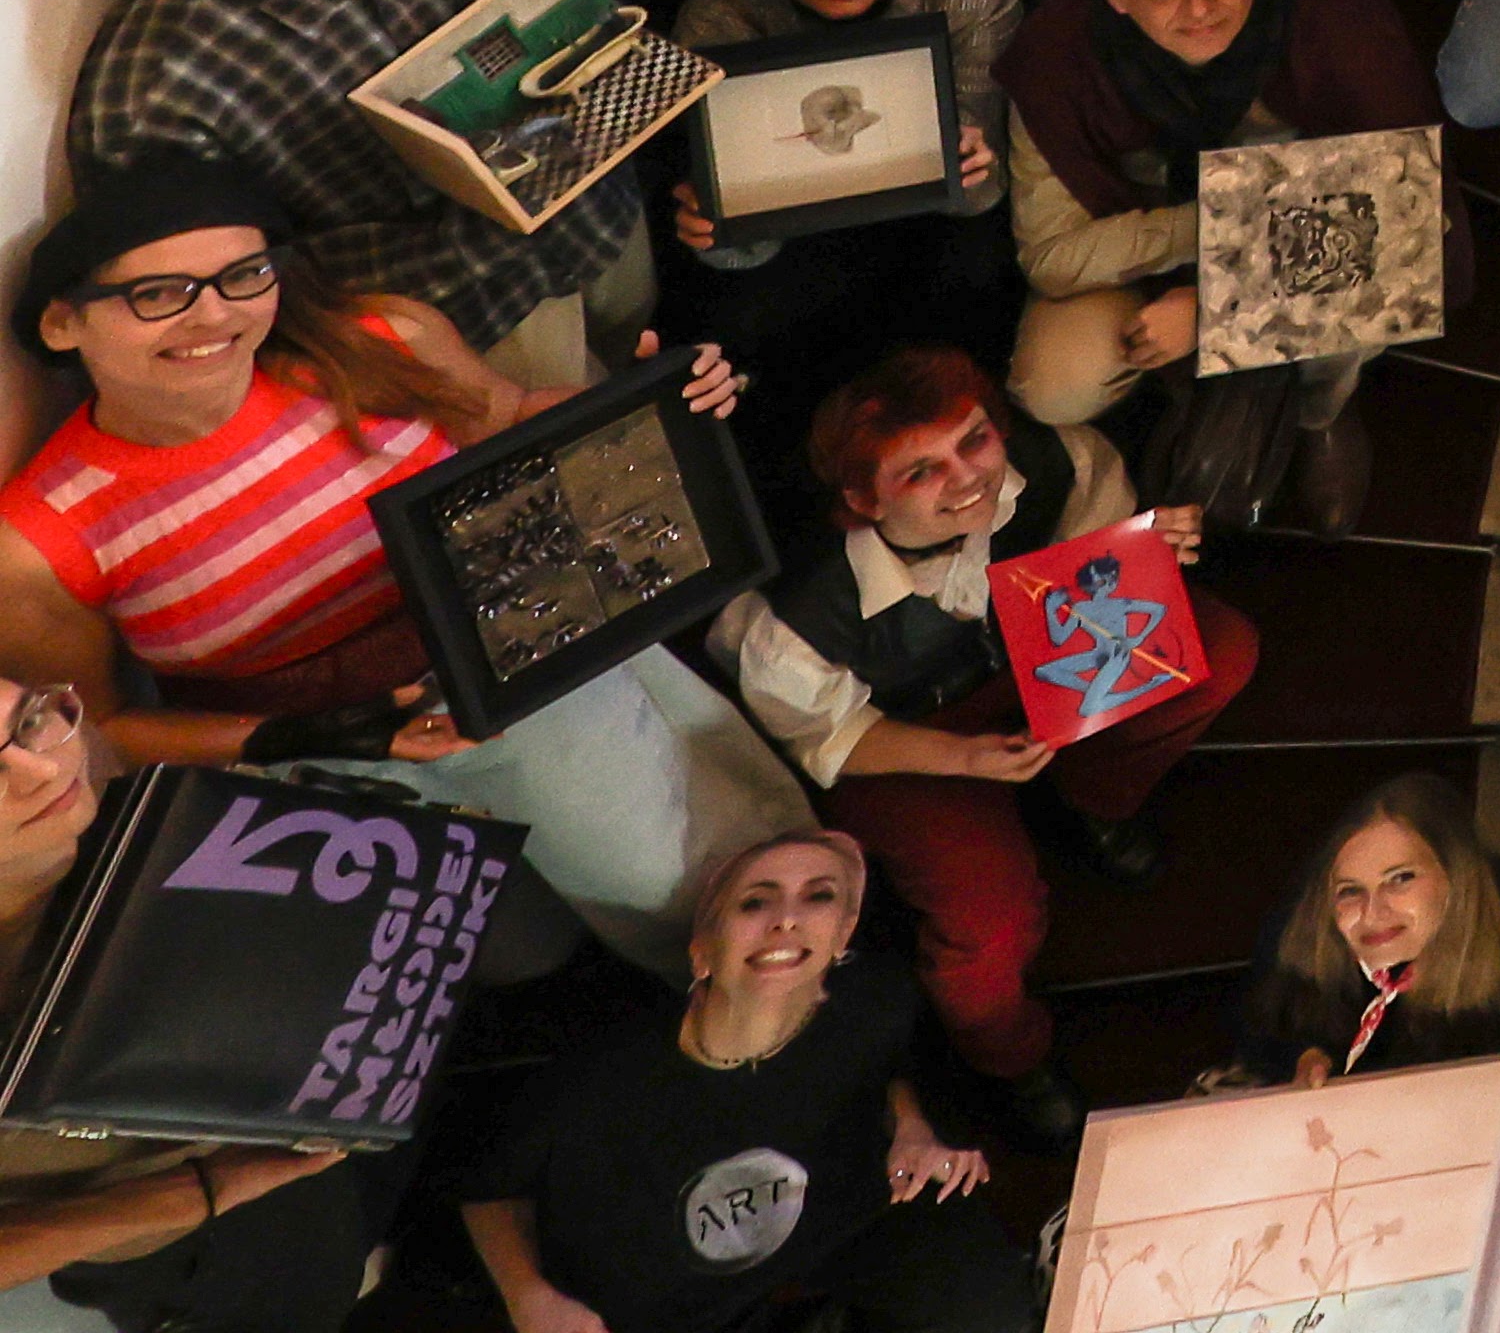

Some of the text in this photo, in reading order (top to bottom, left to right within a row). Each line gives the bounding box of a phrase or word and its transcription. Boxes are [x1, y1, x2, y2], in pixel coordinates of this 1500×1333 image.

[288, 888, 426, 1117] TARGI
[329, 822, 477, 1123] MŁODEJ
[376, 857, 508, 1126] SZTUKI
[698, 1176, 789, 1242] ART
